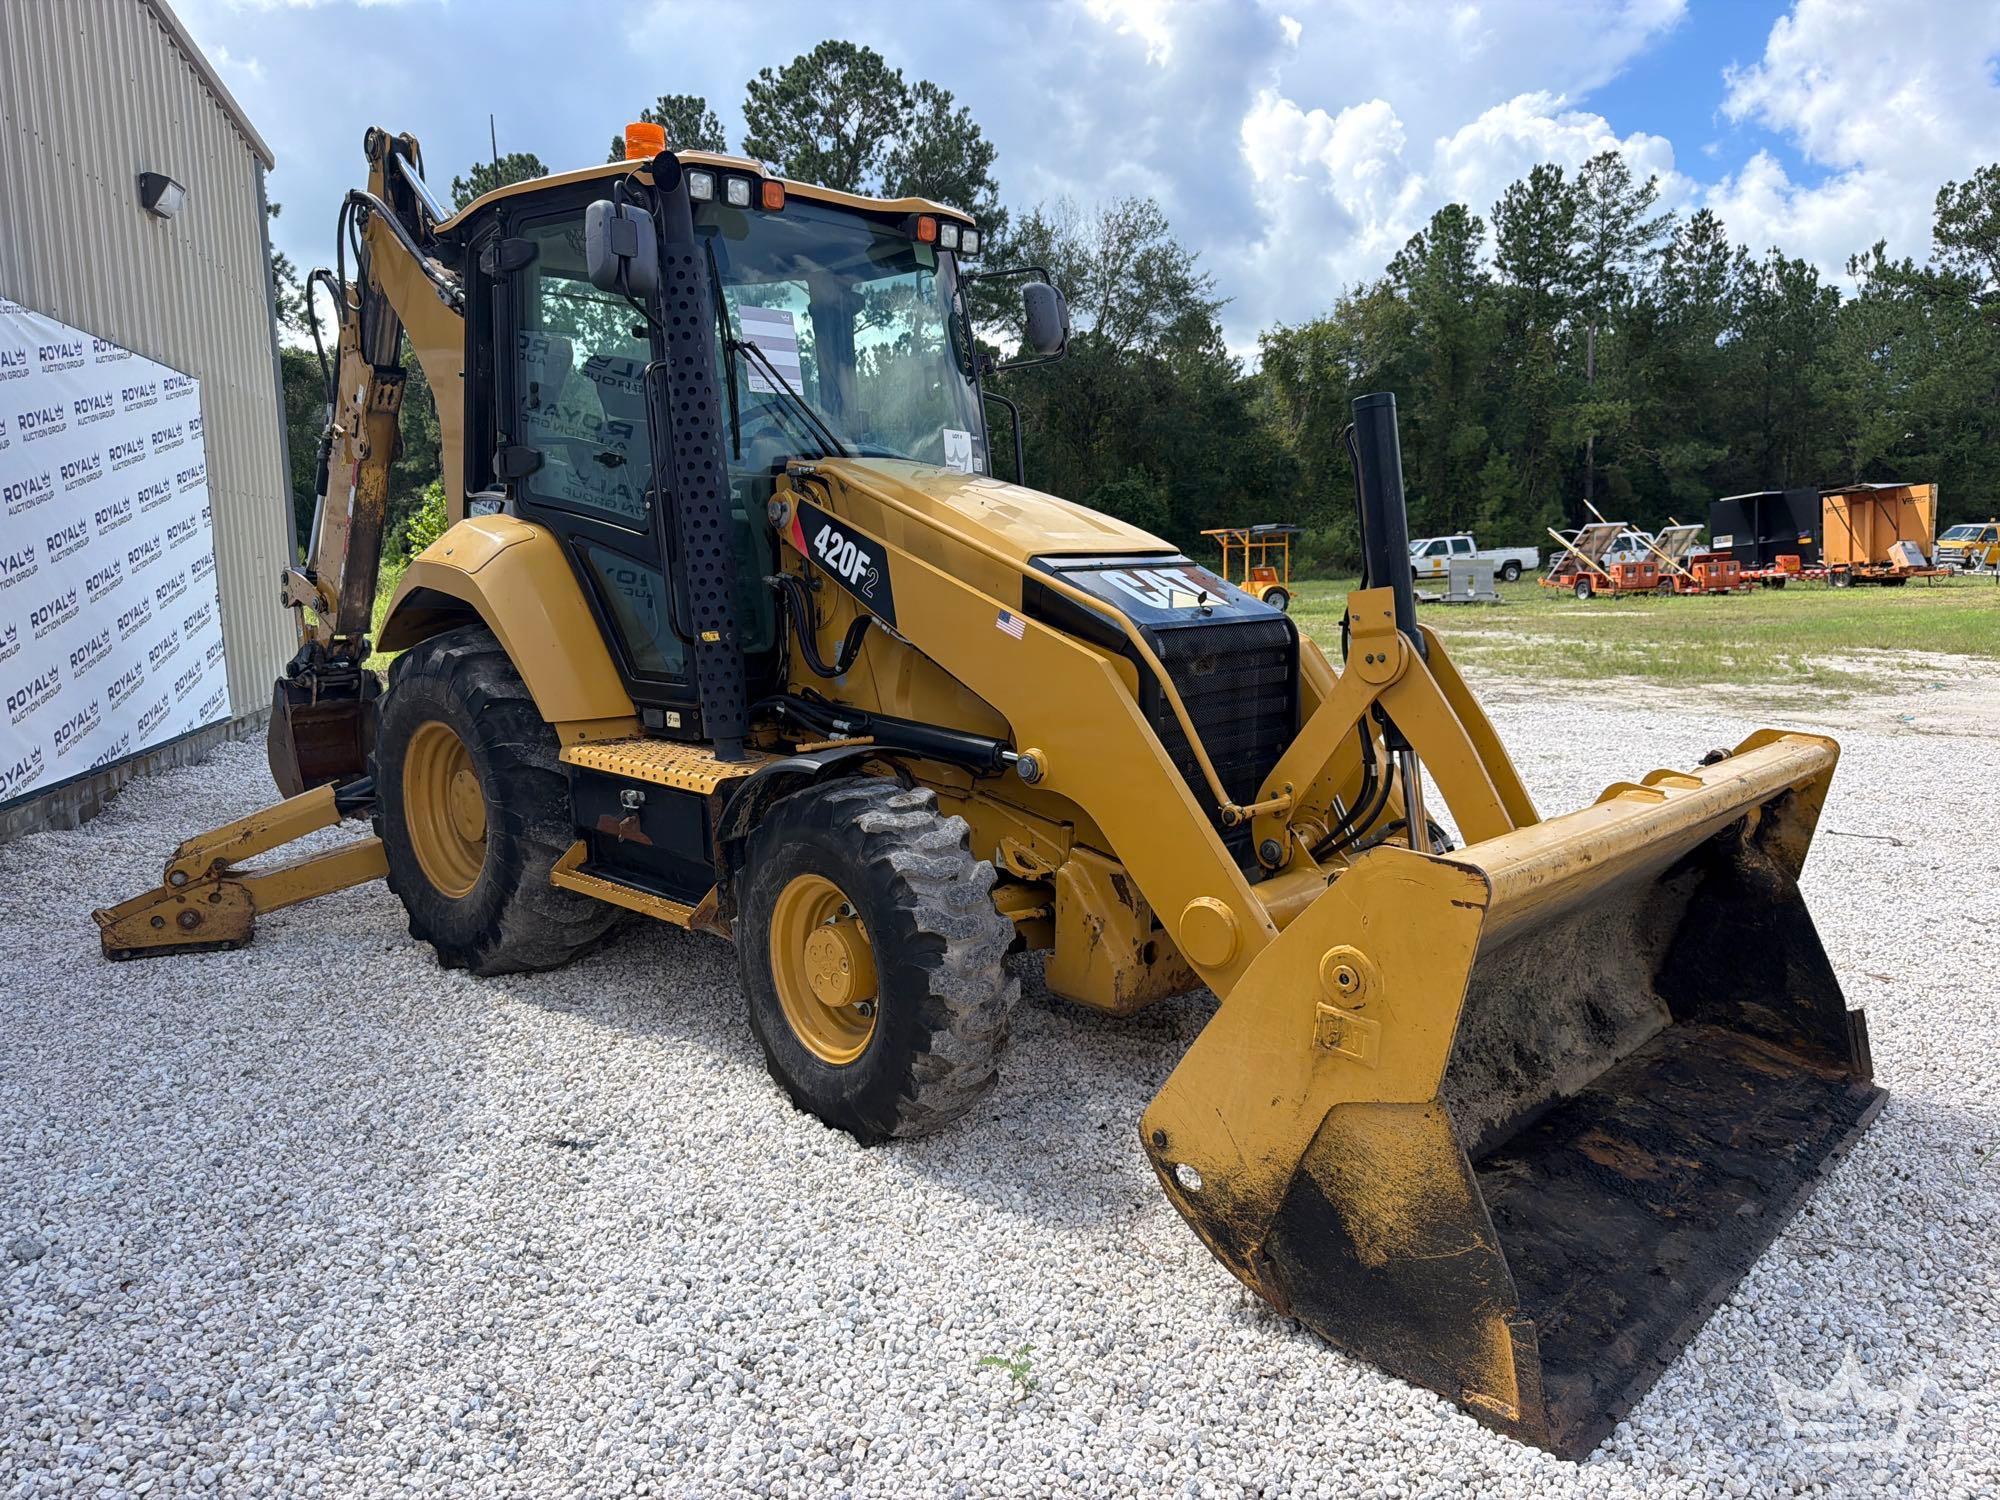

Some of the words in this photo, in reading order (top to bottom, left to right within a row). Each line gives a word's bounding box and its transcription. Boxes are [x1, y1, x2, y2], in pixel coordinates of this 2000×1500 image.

[39, 343, 74, 361] ROYAL
[8, 368, 29, 380] GROUP
[42, 363, 66, 373] AUCTION
[67, 359, 85, 369] GROUP
[122, 384, 150, 402] ROYAL
[163, 376, 187, 391] ROYAL
[74, 395, 106, 415] ROYAL
[77, 414, 98, 426] AUCTION
[97, 409, 115, 421] GROUP
[124, 400, 143, 412] AUCTION
[143, 398, 158, 408] GROUP
[18, 408, 56, 430] ROYAL
[23, 429, 48, 443] AUCTION
[48, 423, 67, 435] GROUP
[152, 427, 177, 445] ROYAL
[109, 441, 138, 461] ROYAL
[60, 457, 93, 480] ROYAL
[65, 477, 86, 492] AUCTION
[86, 470, 103, 483] GROUP
[177, 466, 200, 485] ROYAL
[3, 477, 43, 504] ROYAL
[8, 498, 36, 516] AUCTION
[36, 490, 55, 505] GROUP
[138, 482, 164, 504] ROYAL
[95, 501, 124, 526] ROYAL
[99, 520, 118, 536] AUCTION
[118, 512, 133, 527] GROUP
[46, 525, 80, 553] ROYAL
[167, 519, 190, 541] ROYAL
[50, 546, 74, 564] AUCTION
[73, 536, 90, 552] GROUP
[128, 540, 154, 565] ROYAL
[0, 552, 26, 575] YAL
[191, 554, 214, 575] ROYAL
[0, 576, 16, 591] TION
[16, 564, 39, 582] GROUP
[86, 566, 115, 594] ROYAL
[90, 586, 110, 604] AUCTION
[109, 575, 124, 591] GROUP
[156, 577, 180, 601] ROYAL
[1100, 569, 1231, 609] CAT
[30, 595, 69, 629] ROYAL
[35, 618, 61, 640] AUCTION
[61, 606, 80, 623] GROUP
[117, 603, 144, 632] ROYAL
[184, 606, 205, 632] ROYAL
[70, 636, 103, 669] ROYAL
[74, 657, 97, 680] AUCTION
[96, 644, 113, 662] GROUP
[149, 635, 173, 663] ROYAL
[107, 666, 136, 702] ROYAL
[175, 666, 196, 694] ROYAL
[6, 674, 50, 714] ROYAL
[11, 698, 41, 726] AUCTION
[40, 683, 62, 704] GROUP
[199, 692, 220, 720] ROYAL
[54, 709, 91, 747] ROYAL
[137, 701, 164, 733] ROYAL
[57, 730, 82, 758] AUCTION
[83, 716, 101, 737] GROUP
[0, 757, 32, 793] OYAL
[21, 764, 45, 788] GROUP
[1322, 1014, 1369, 1058] CAT
